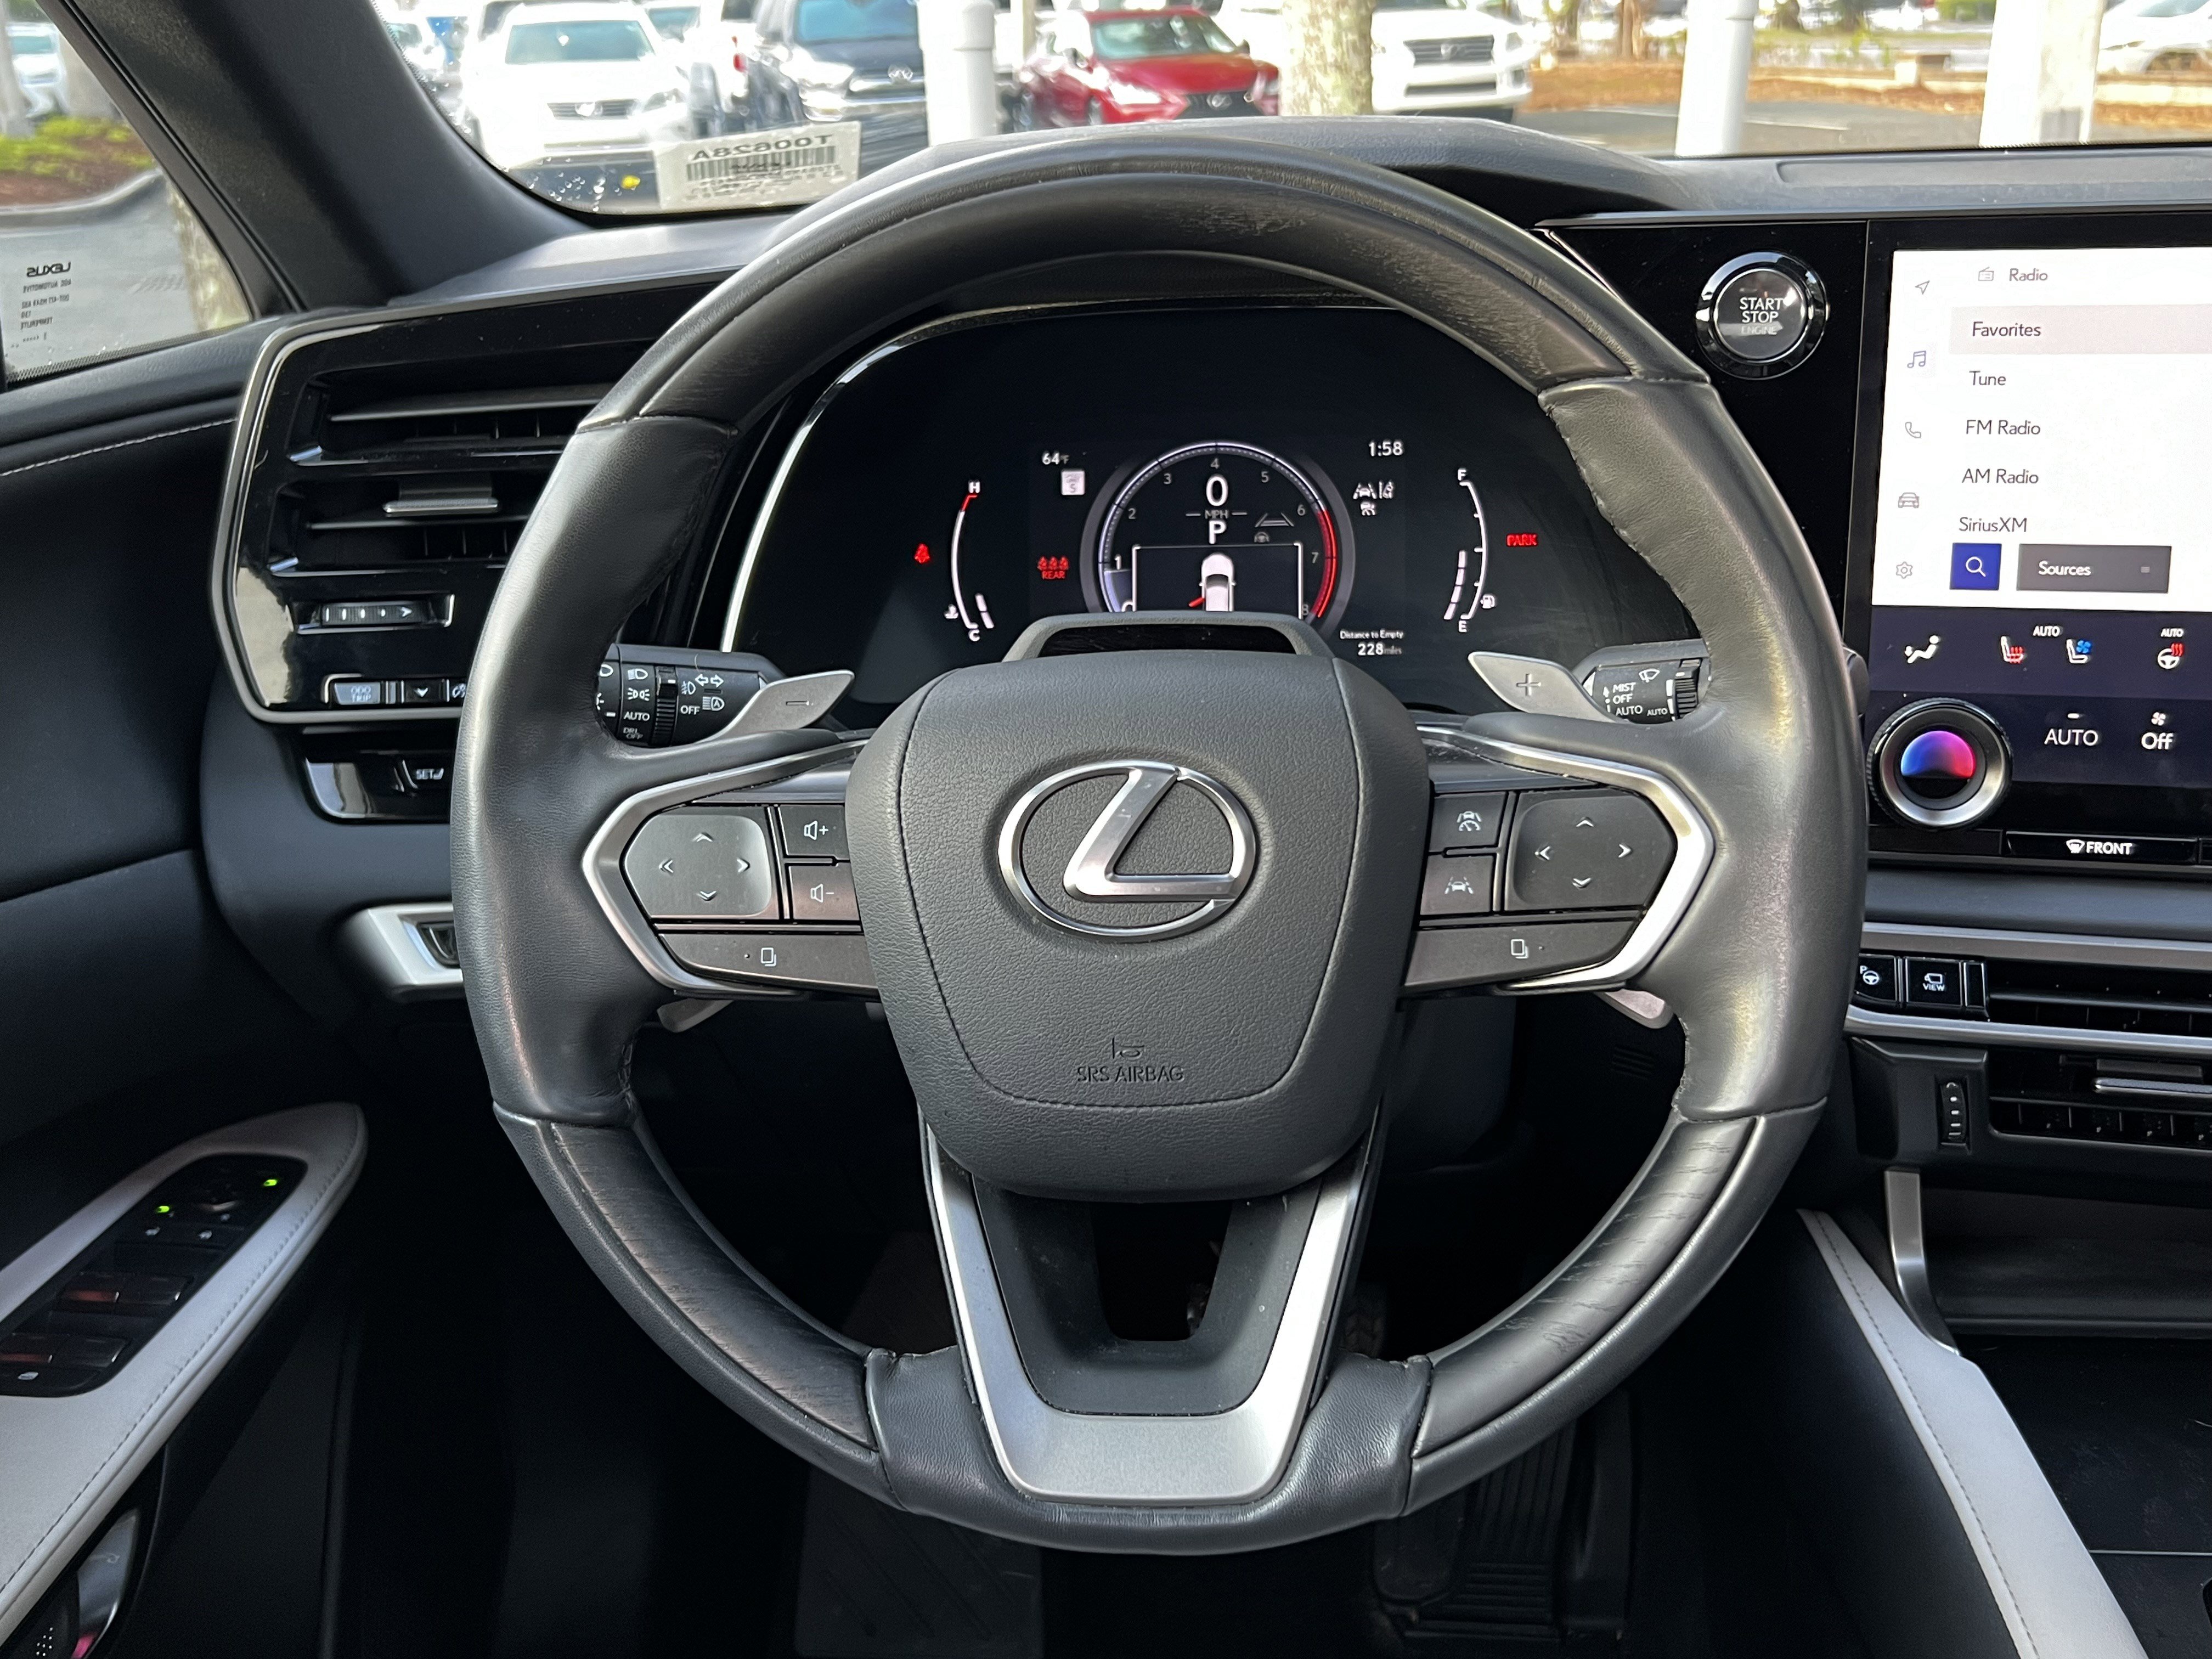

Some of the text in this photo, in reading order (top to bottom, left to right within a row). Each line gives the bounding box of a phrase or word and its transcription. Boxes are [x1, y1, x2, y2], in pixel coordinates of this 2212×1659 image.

[2009, 268, 2049, 282] Radio
[1740, 297, 1784, 311] START
[1742, 311, 1779, 323] STOP
[1741, 325, 1778, 335] ENGINE
[1972, 321, 2042, 338] Favorites
[1968, 370, 2006, 386] Tune
[1966, 420, 2041, 436] FM Radio
[1368, 440, 1404, 456] 1:58
[1210, 458, 1219, 469] 4
[1163, 472, 1172, 485] 3
[1261, 471, 1269, 483] 5
[1457, 468, 1467, 481] F
[1961, 469, 2039, 484] AM Radio
[968, 480, 981, 494] H
[1205, 474, 1229, 506] 0
[1128, 507, 1137, 520] 2
[1204, 510, 1228, 519] MPH
[1296, 504, 1306, 516] 6
[1959, 517, 2028, 532] SiriusXM
[1208, 519, 1227, 545] P
[1506, 534, 1538, 546] PARK
[1114, 553, 1122, 570] 1
[1311, 551, 1319, 563] 7
[1042, 571, 1065, 579] REAR
[2038, 561, 2092, 577] Sources
[1458, 620, 1468, 633] E
[2033, 625, 2061, 637] AUTO
[2160, 628, 2184, 638] AUTO
[968, 629, 980, 642] C
[1339, 630, 1370, 639] Distance
[1380, 629, 1404, 639] Empty
[1357, 642, 1384, 656] 228
[1612, 682, 1636, 693] MIST
[1612, 693, 1633, 704] OFF
[623, 712, 650, 721] AUTO
[680, 705, 701, 715] OFF
[1615, 705, 1643, 716] AUTO
[1647, 708, 1668, 716] AUTO
[623, 726, 637, 735] DRL
[2044, 729, 2099, 747] AUTO
[2141, 733, 2175, 751] Off
[416, 769, 435, 780] SET
[2086, 840, 2134, 855] FRONT
[1922, 983, 1945, 991] VIEW
[1077, 1065, 1184, 1082] SRS AIRBAG
